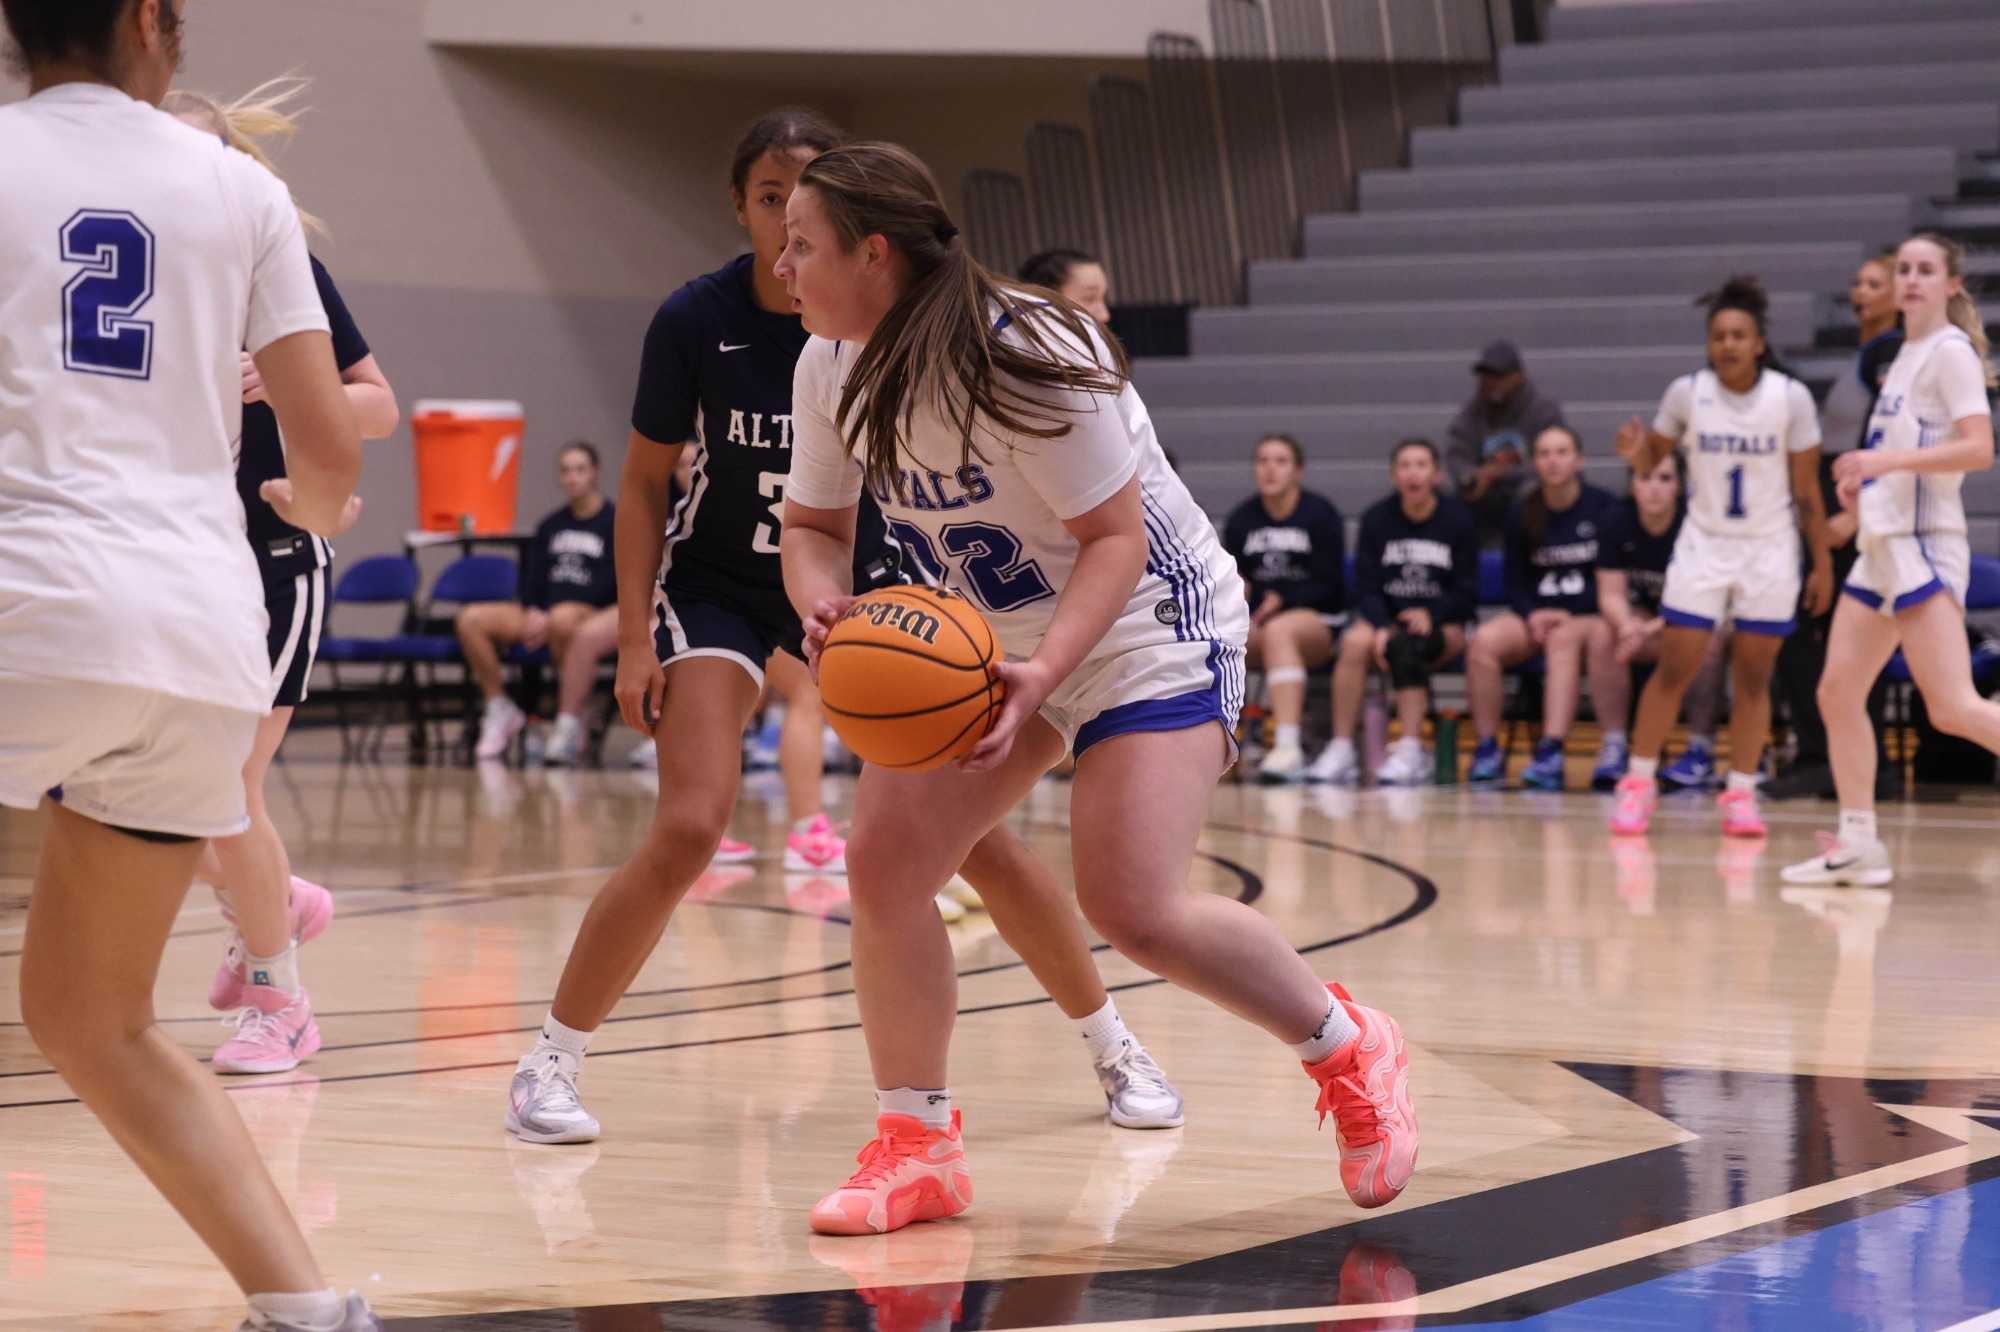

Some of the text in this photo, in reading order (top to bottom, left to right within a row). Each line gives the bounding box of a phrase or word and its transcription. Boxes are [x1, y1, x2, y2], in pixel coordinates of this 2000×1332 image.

[59, 208, 155, 381] 2
[727, 409, 793, 448] ALT
[752, 471, 788, 554] 3
[1725, 463, 1746, 518] 1
